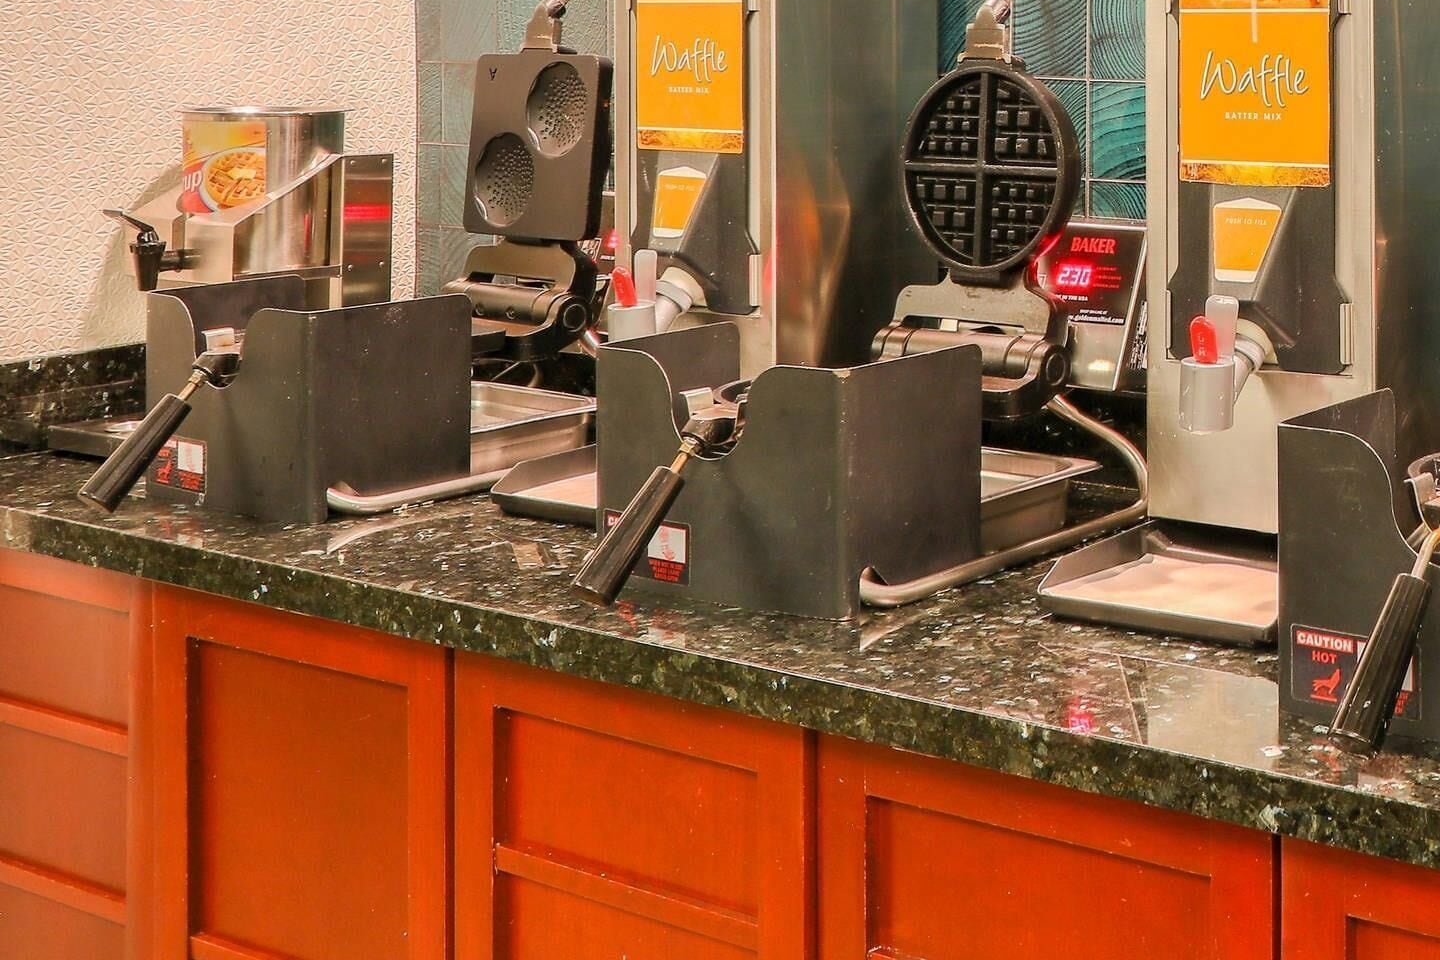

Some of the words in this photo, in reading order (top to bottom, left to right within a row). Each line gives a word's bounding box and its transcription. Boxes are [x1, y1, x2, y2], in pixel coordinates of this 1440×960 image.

[650, 35, 728, 82] Waffle
[1200, 50, 1309, 107] Waffle
[1225, 111, 1258, 120] BATTER
[1264, 112, 1281, 121] MIX
[1071, 237, 1117, 254] BAKER
[1297, 632, 1353, 652] CAUTION
[1312, 651, 1337, 664] HOT
